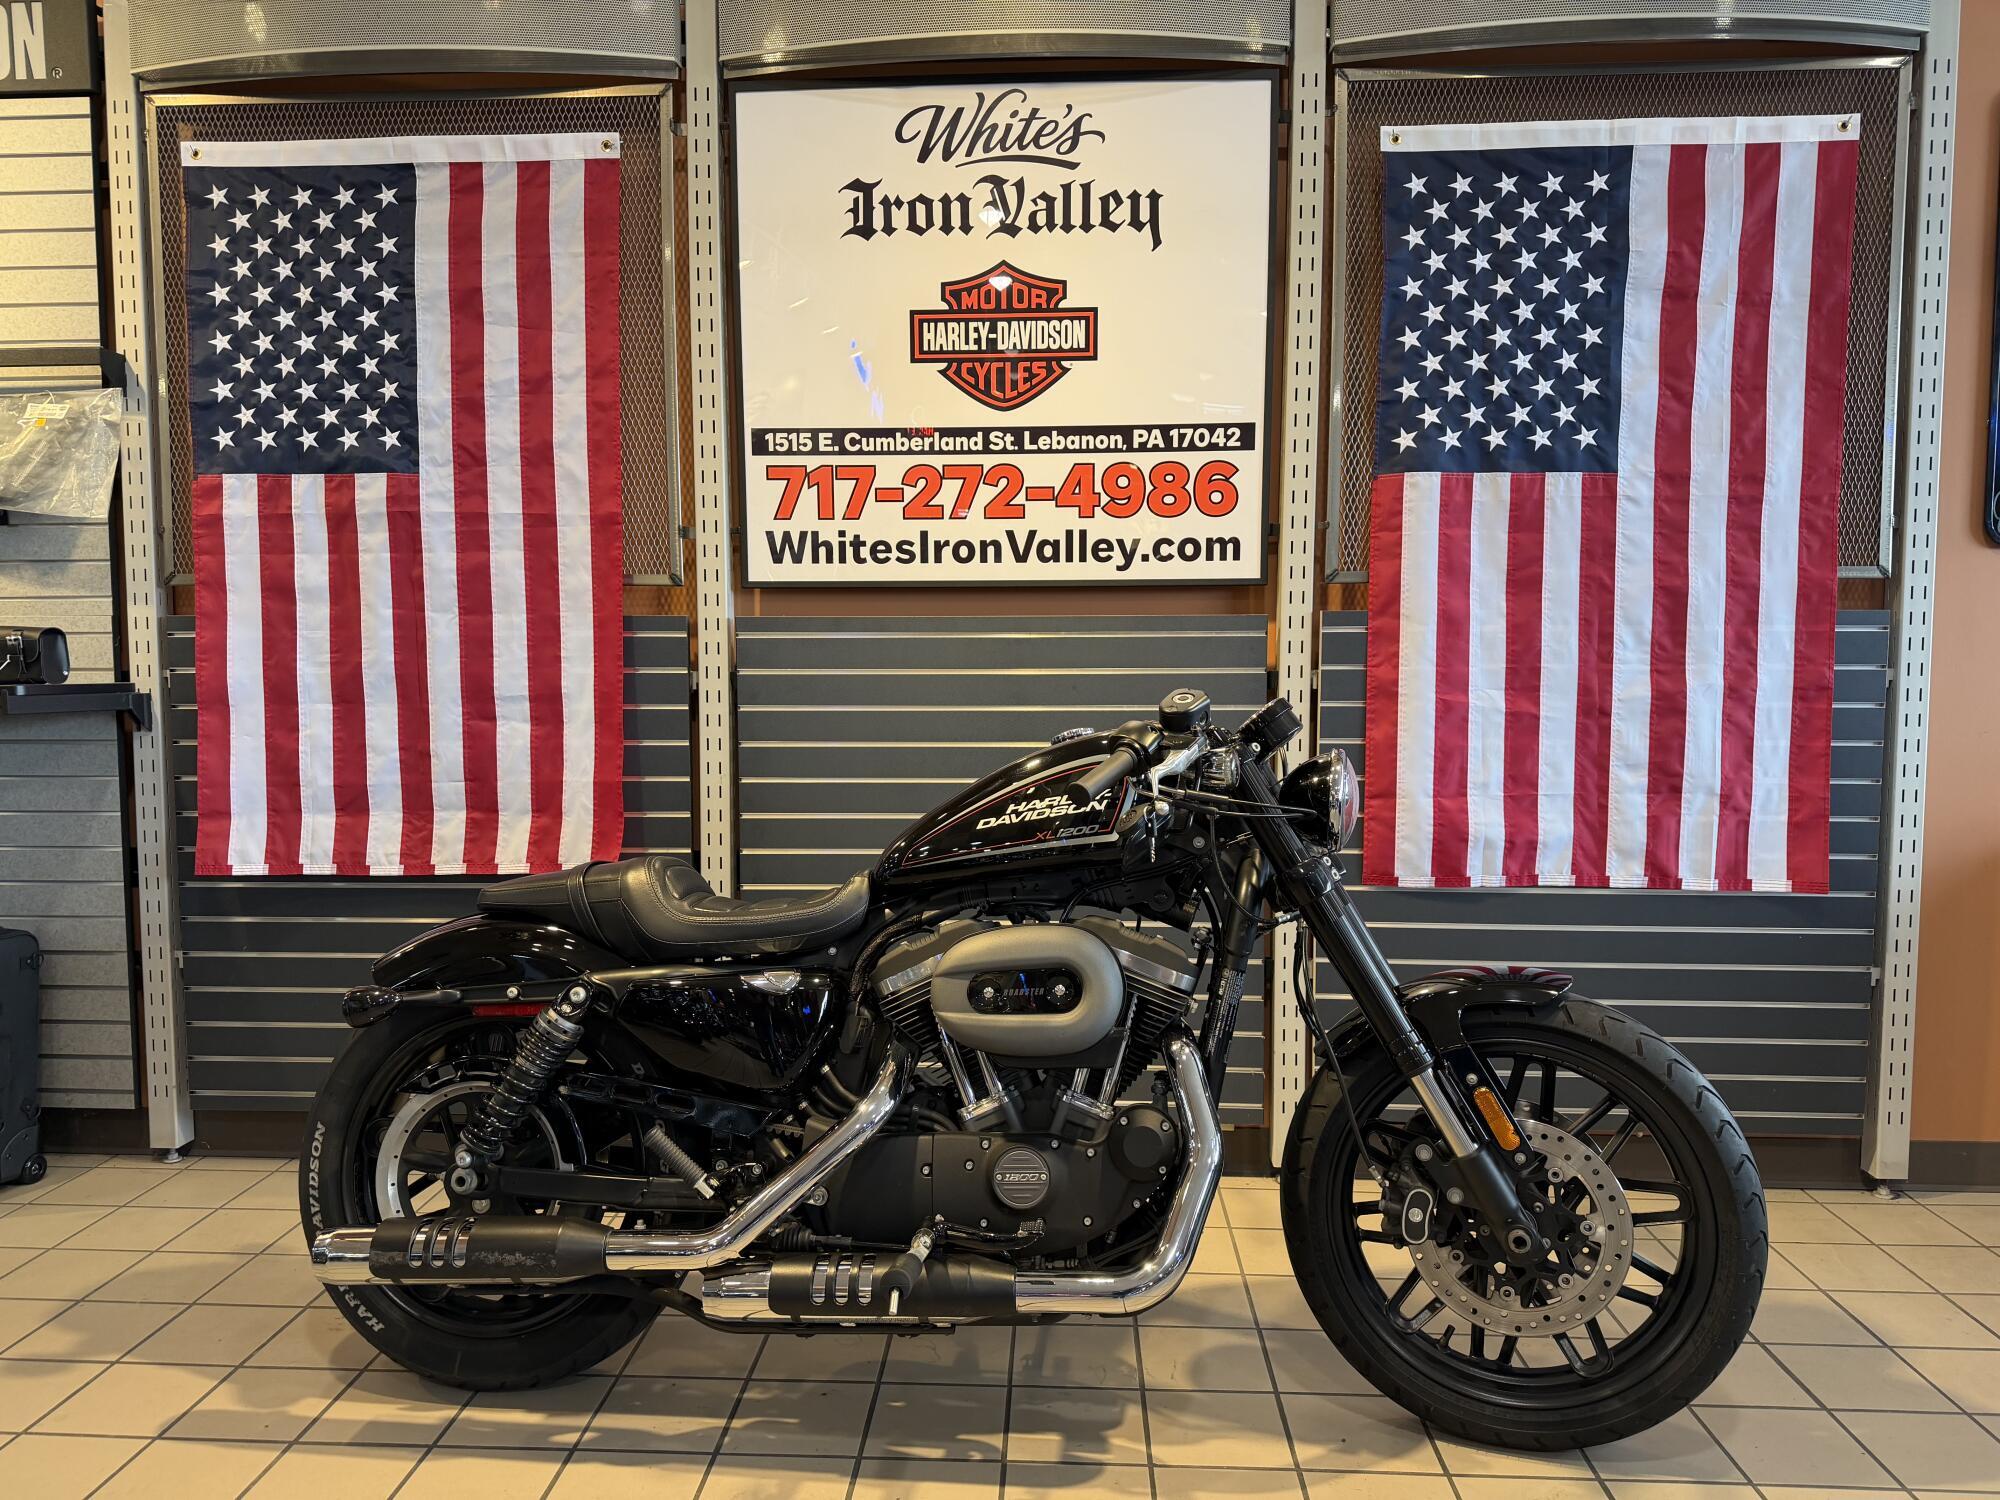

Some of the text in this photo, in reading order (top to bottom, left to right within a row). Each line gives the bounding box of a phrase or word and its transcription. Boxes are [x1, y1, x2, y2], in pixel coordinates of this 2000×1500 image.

[895, 88, 1106, 164] White's
[838, 174, 1164, 252] Iron Valley
[961, 282, 1048, 310] MOTOR
[922, 319, 1086, 352] HARLEY-DAVIDSON
[960, 361, 1047, 400] CYCLES
[765, 433, 813, 452] 1515
[818, 433, 839, 451] E.
[844, 431, 983, 451] Cumberland
[988, 431, 1018, 450] St.
[1023, 430, 1127, 451] Lebanon,
[1132, 429, 1164, 449] PA
[1169, 427, 1241, 448] 17042
[765, 460, 1240, 521] 717-272-4986
[765, 529, 1242, 572] WhitesIronValley.com
[308, 1120, 326, 1238] AVIDSON
